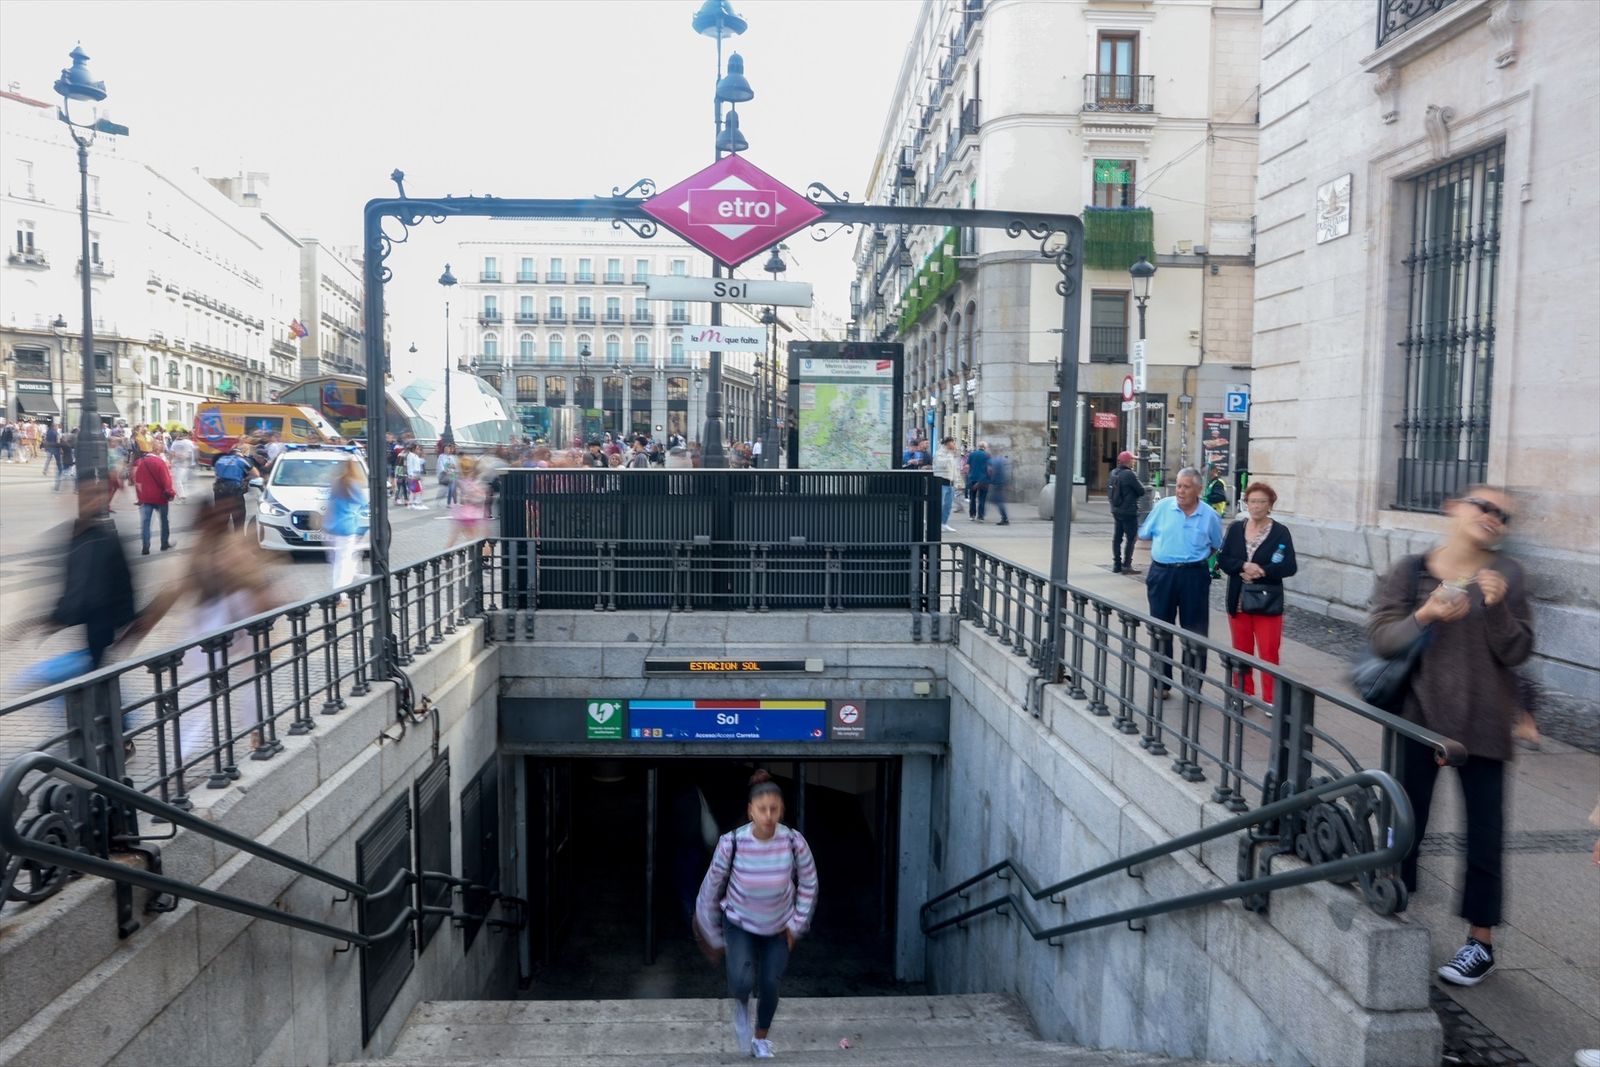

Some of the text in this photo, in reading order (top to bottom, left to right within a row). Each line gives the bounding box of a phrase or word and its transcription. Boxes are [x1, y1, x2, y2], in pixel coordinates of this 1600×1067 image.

[718, 197, 770, 218] etro
[714, 282, 747, 298] Sol
[690, 662, 760, 671] ESTACION SOL
[717, 713, 739, 725] Sol
